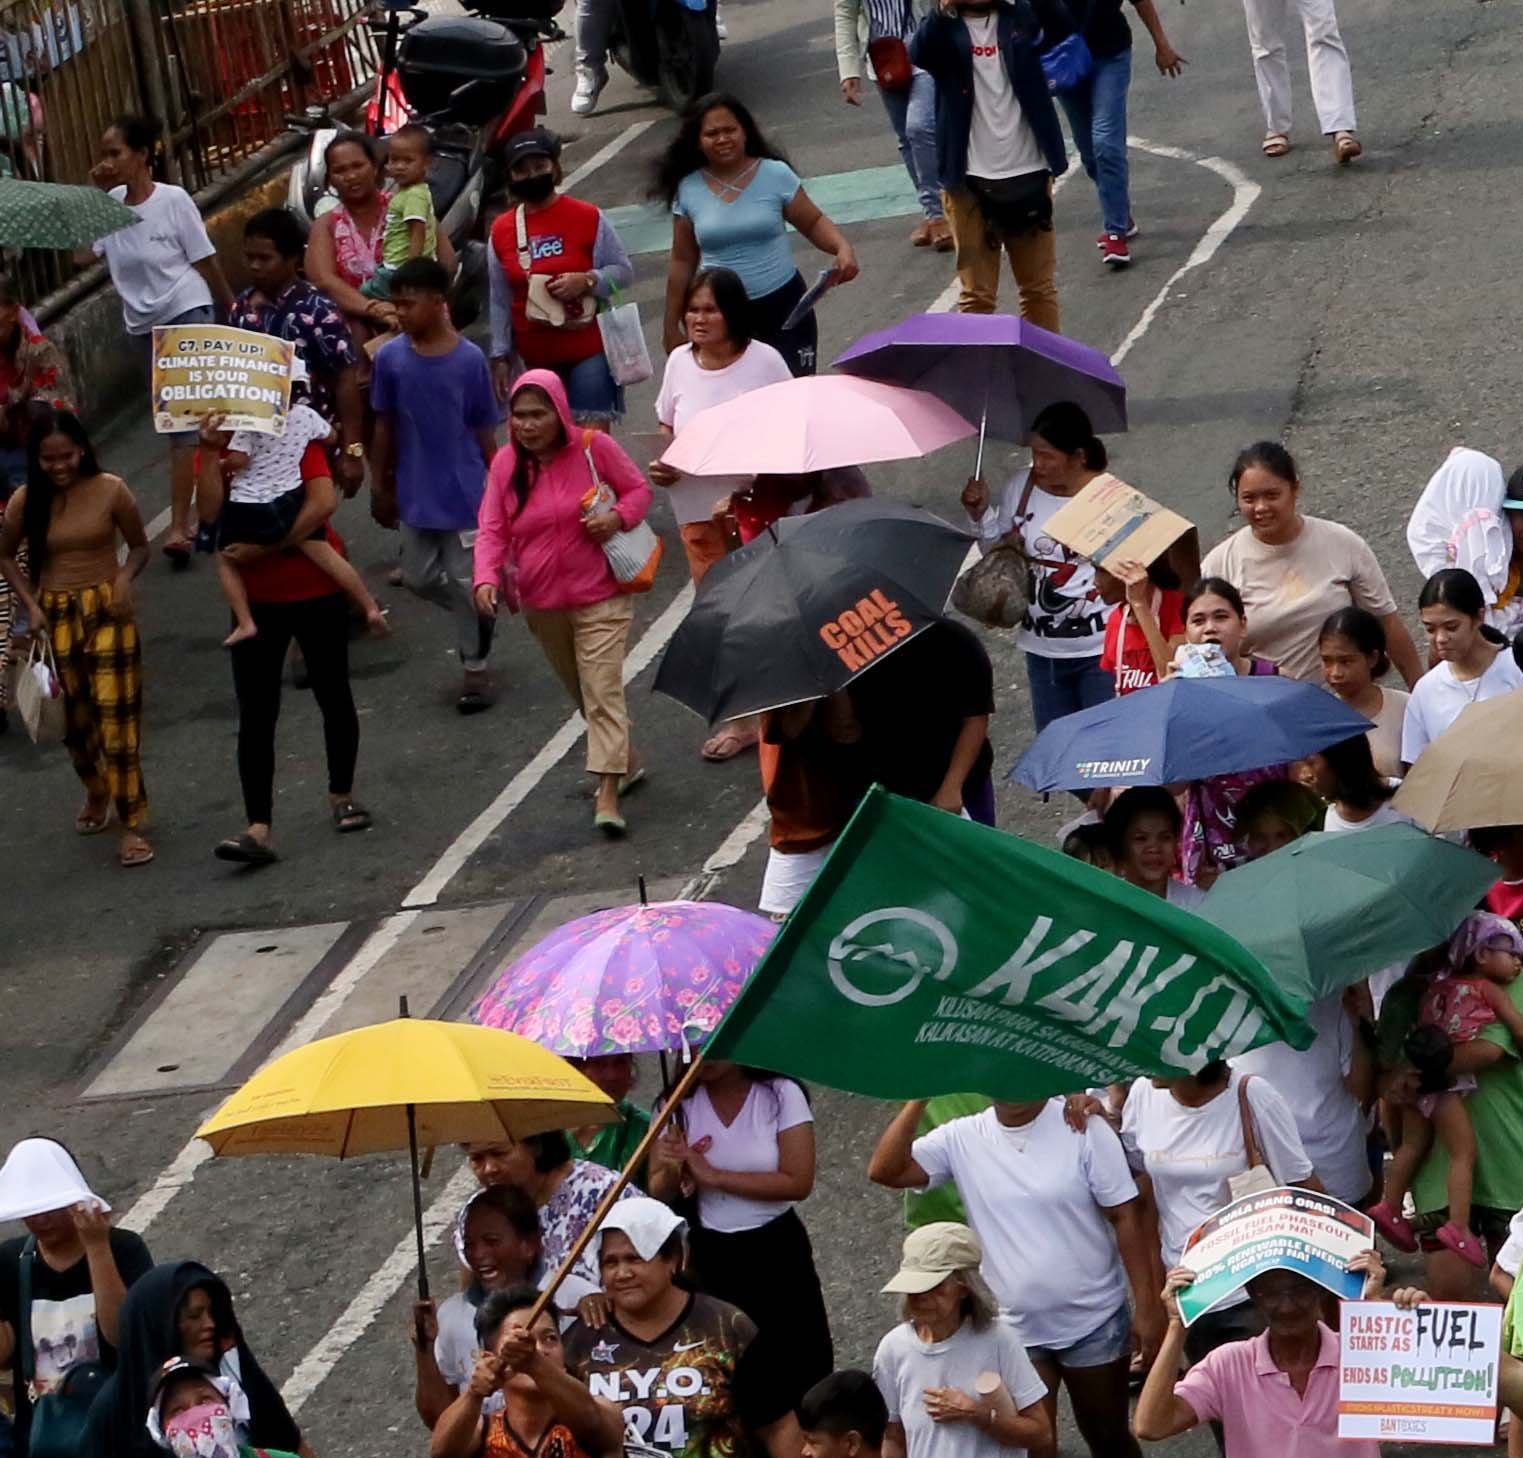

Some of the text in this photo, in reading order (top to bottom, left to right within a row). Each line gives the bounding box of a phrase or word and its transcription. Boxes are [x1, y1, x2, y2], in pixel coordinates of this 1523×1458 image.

[532, 240, 562, 259] Lee
[203, 341, 233, 351] PAY
[239, 344, 264, 356] UP!
[158, 356, 288, 376] CLIMATE FINANCE
[190, 370, 249, 383] IS YOUR
[161, 384, 281, 405] OBLIGATION!
[820, 588, 899, 650] COAL
[838, 610, 913, 672] KILLS
[1092, 758, 1151, 773] TRINITY
[1217, 1203, 1251, 1226] WALA
[1254, 1196, 1294, 1211] NANG
[1201, 1213, 1351, 1253] FOSSIL FUEL PHASEOUT
[1232, 1223, 1314, 1246] BILISAN NA!
[1195, 1263, 1226, 1284] 00%
[1227, 1239, 1303, 1266] RENEWABLE
[1231, 1248, 1310, 1275] NGAYON NA!
[1350, 1316, 1413, 1334] PLASTIC
[1417, 1309, 1484, 1351] FUEL
[1350, 1336, 1411, 1352] STARTS AS
[589, 1367, 711, 1401] N.Y.O.
[1343, 1362, 1494, 1399] ENDS AS POLLUTION!
